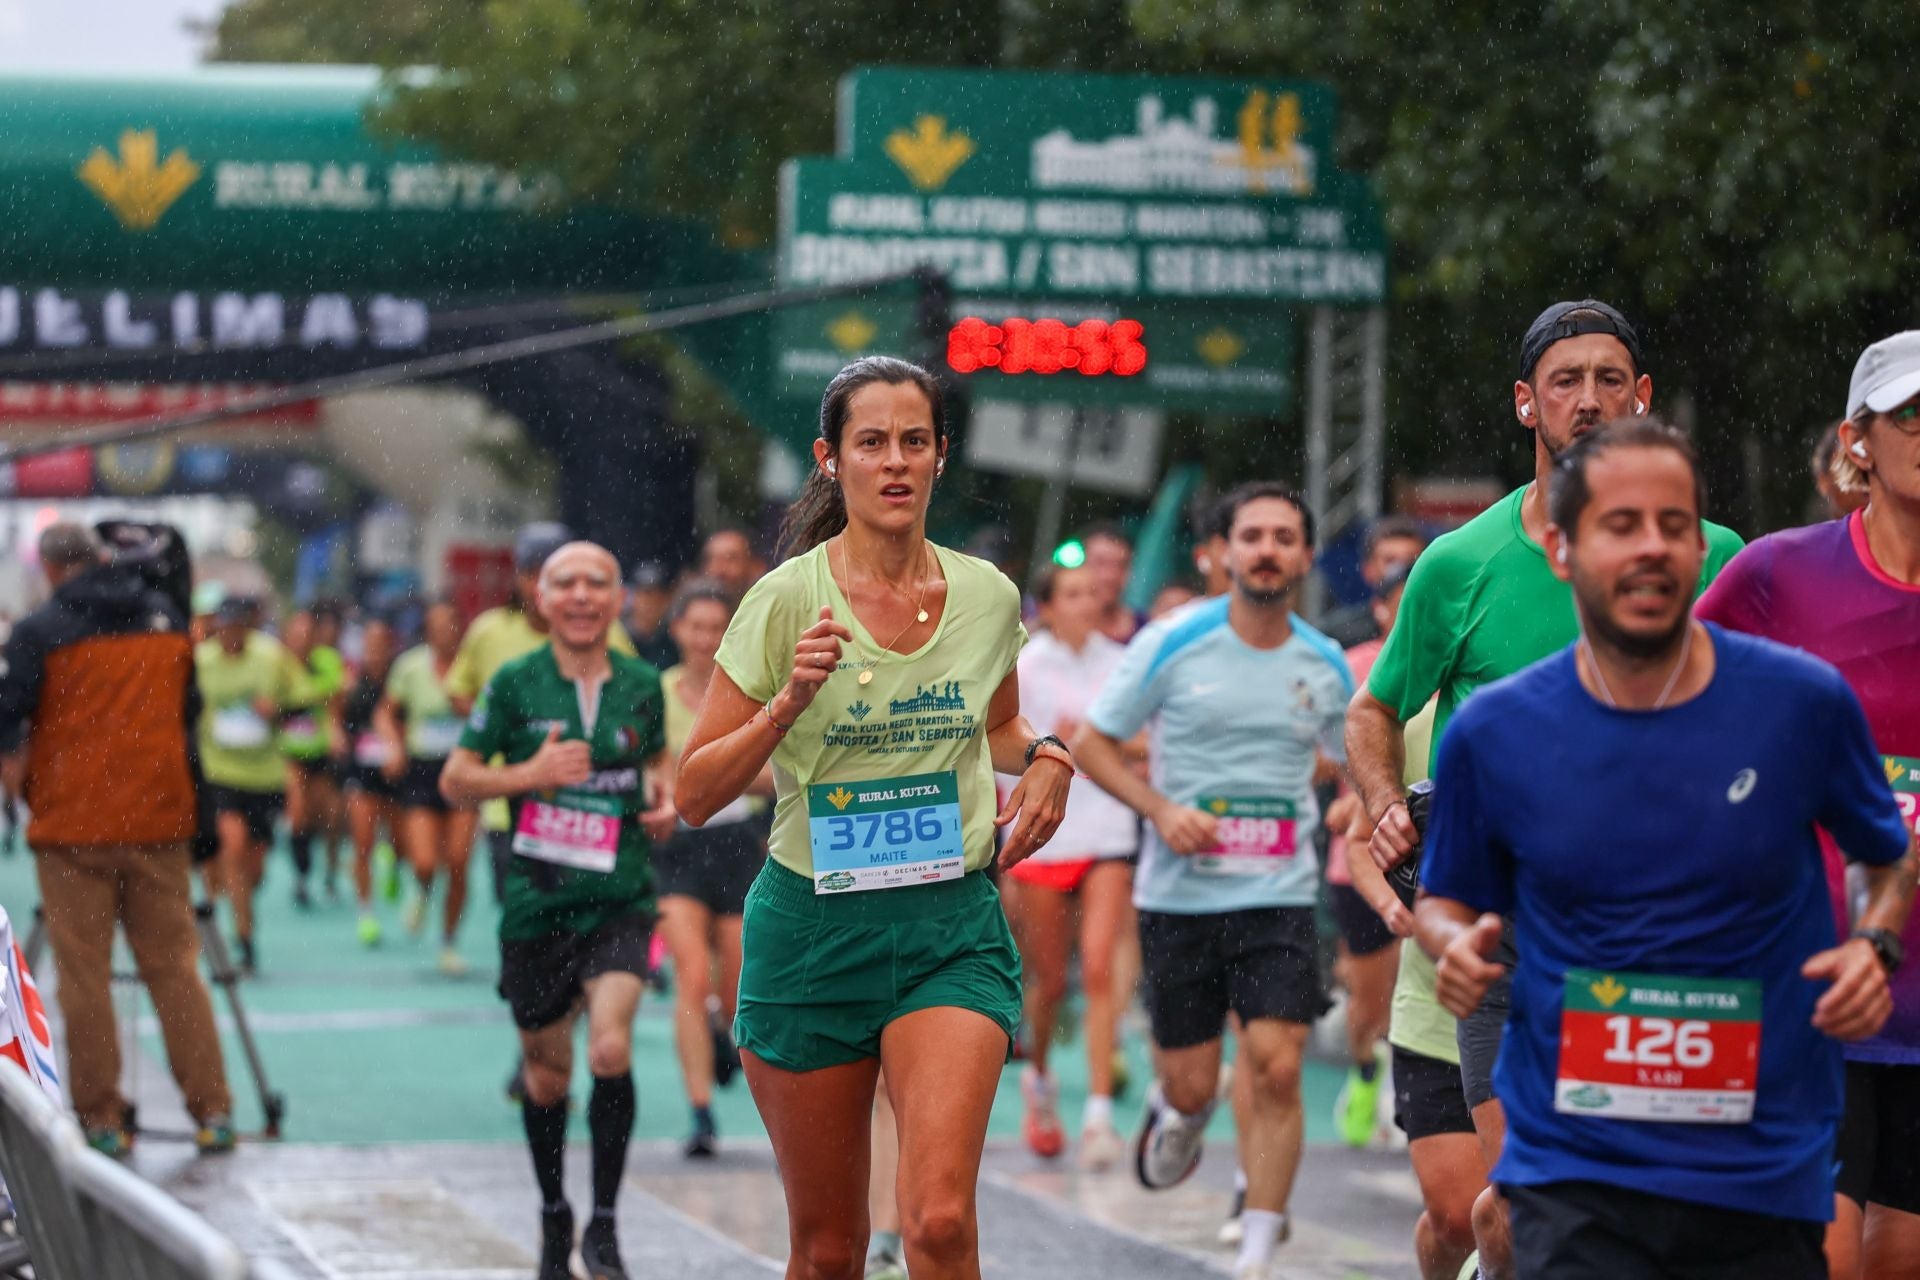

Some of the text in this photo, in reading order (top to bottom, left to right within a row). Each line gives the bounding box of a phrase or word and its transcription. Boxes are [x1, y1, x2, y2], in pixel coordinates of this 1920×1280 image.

[1050, 241, 1138, 292] SAN
[831, 723, 857, 733] RURAL
[860, 721, 886, 732] KUTXA
[889, 719, 913, 729] MEDIO
[882, 734, 889, 744] /
[891, 730, 915, 743] SAN
[858, 784, 941, 803] RURAL KUTXA
[828, 807, 943, 851] 3786
[870, 850, 908, 863] MAITE
[895, 865, 928, 875] DECIMAS
[1629, 988, 1740, 1010] RURAL KUTXA
[1604, 1015, 1714, 1068] 126
